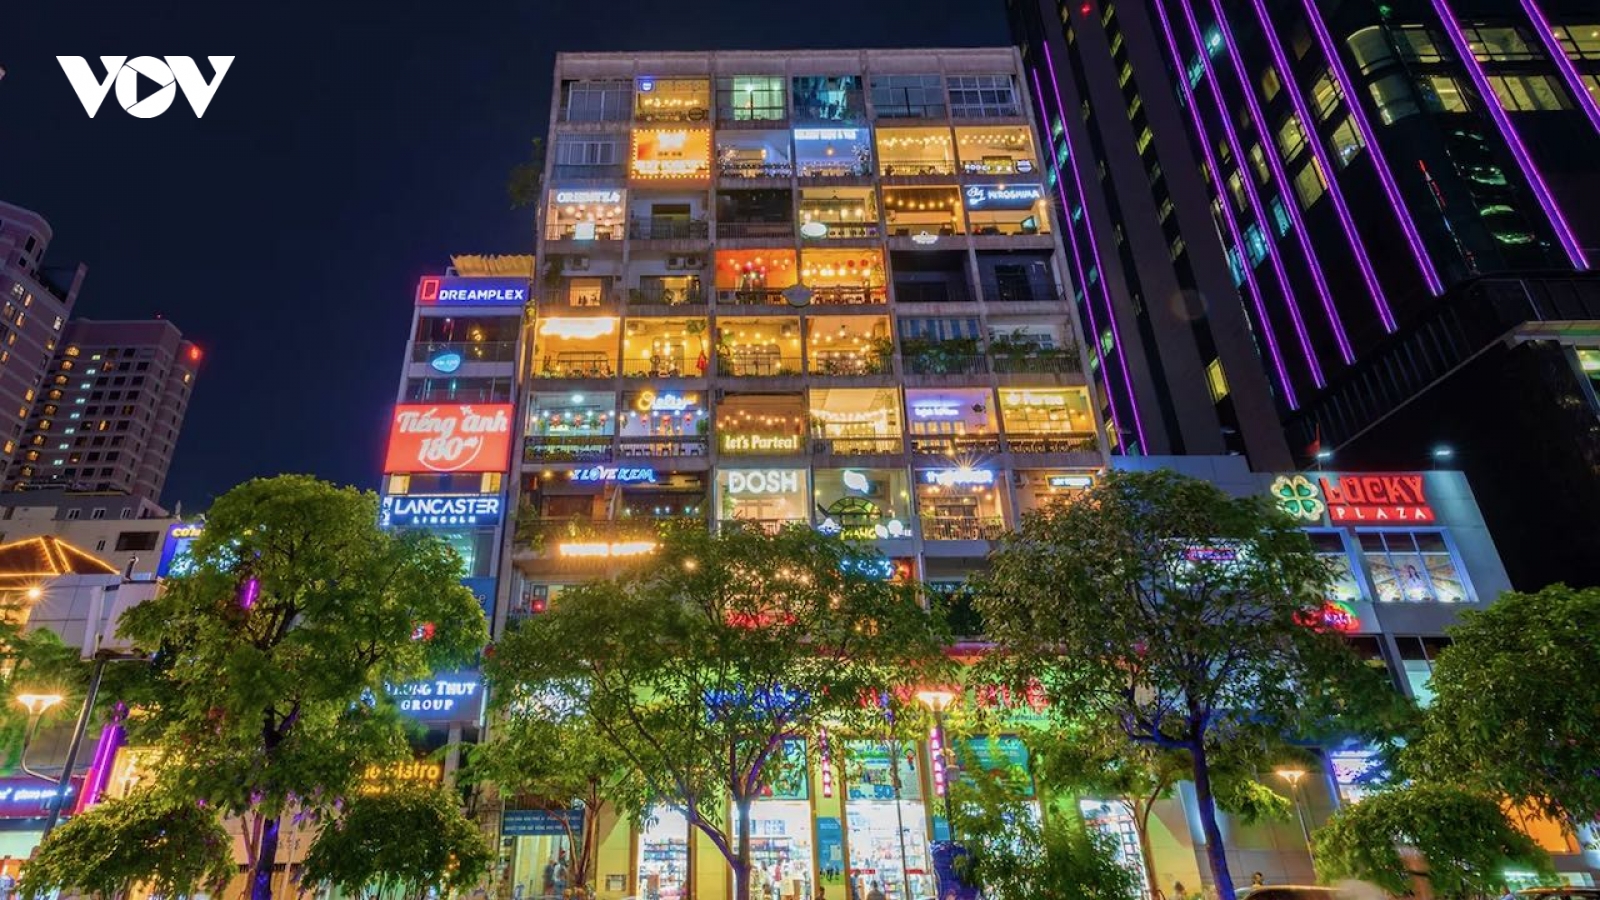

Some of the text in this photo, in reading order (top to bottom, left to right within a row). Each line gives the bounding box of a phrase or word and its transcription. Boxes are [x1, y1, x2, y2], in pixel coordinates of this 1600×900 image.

[439, 288, 525, 301] DREAMPLEX
[418, 437, 464, 461] 180
[583, 465, 618, 481] LOVE
[617, 469, 657, 482] KEM
[728, 470, 799, 494] DOSH
[1319, 474, 1426, 504] LUCKY
[394, 498, 499, 516] LANCASTER
[1337, 508, 1428, 520] PLAZA
[412, 516, 478, 525] LINCOLN
[436, 680, 477, 696] THUY
[401, 699, 454, 711] GROUP
